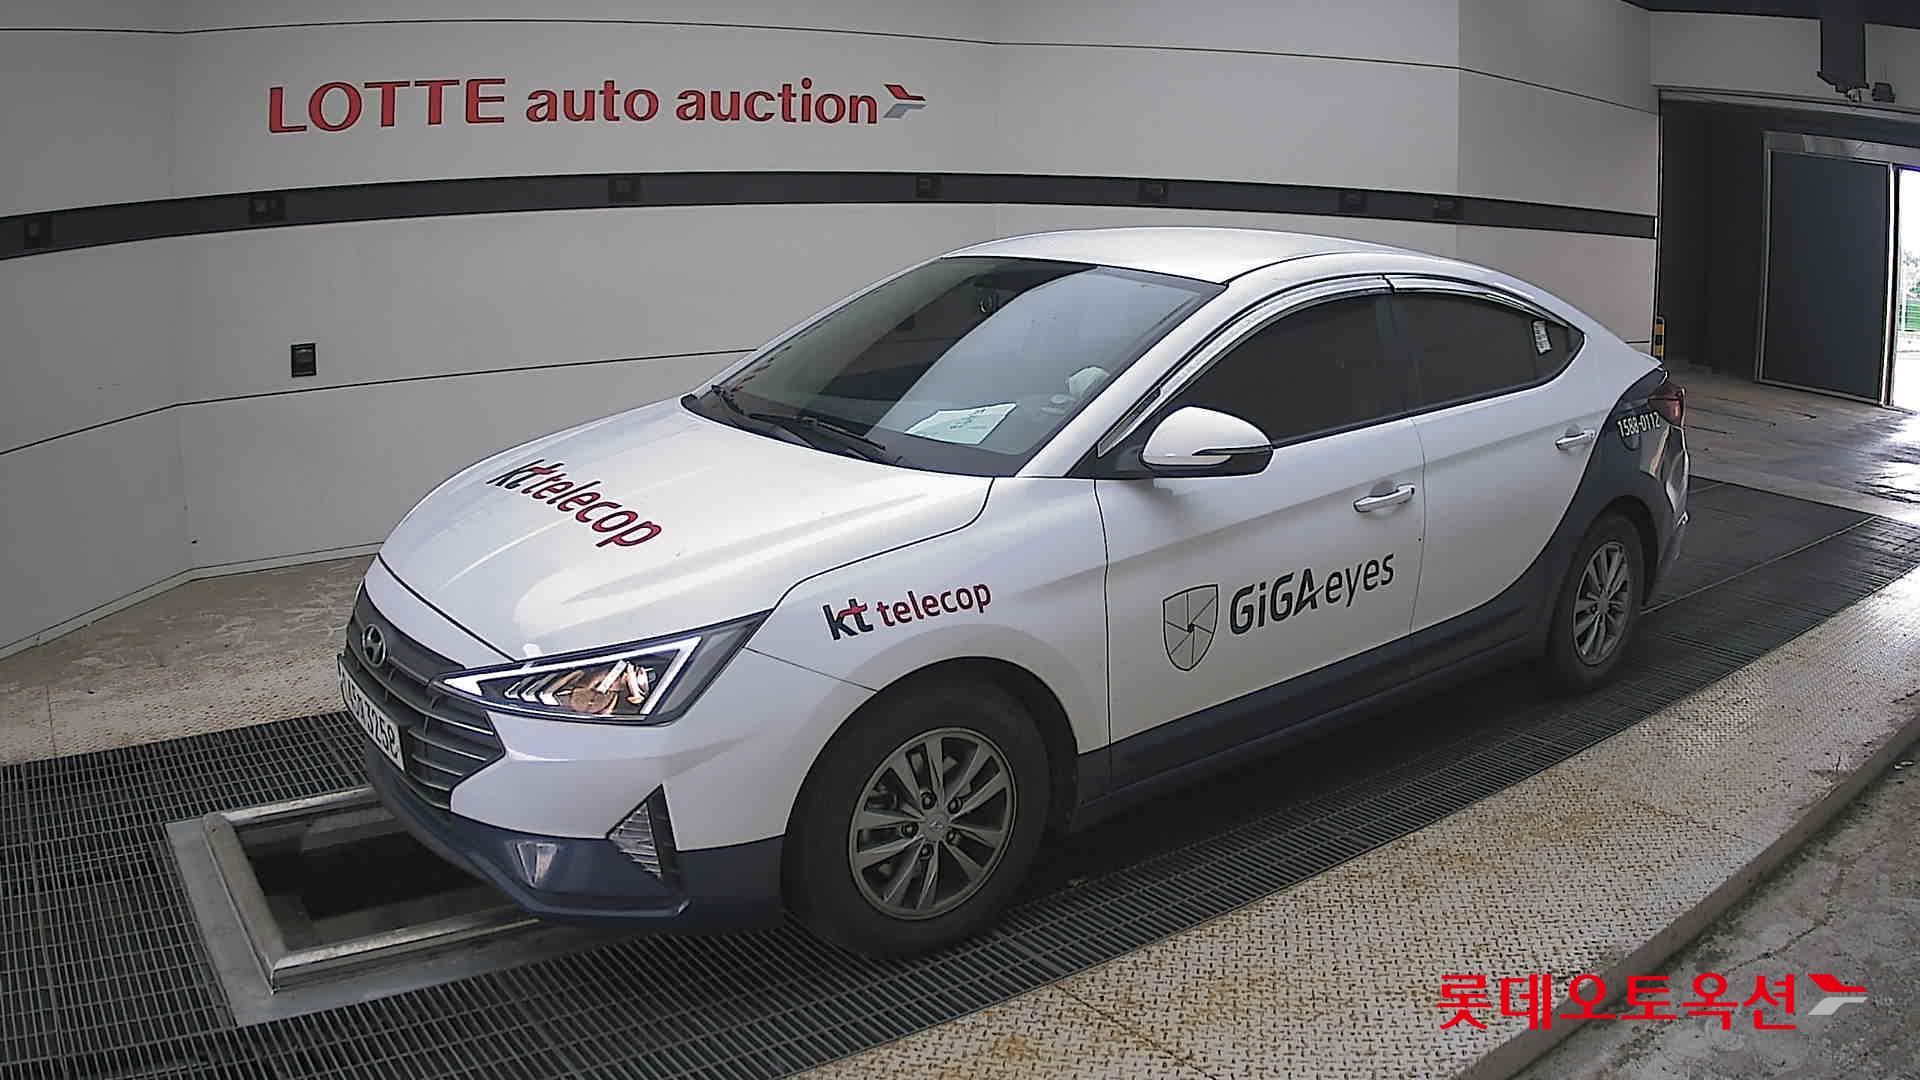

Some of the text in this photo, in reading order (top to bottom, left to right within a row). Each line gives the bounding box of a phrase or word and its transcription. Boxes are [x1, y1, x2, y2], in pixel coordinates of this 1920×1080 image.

[268, 77, 880, 134] LOTTE auto auction
[1617, 411, 1660, 437] 1588-0112
[486, 459, 662, 547] kt telecop
[822, 584, 992, 641] kt telecop
